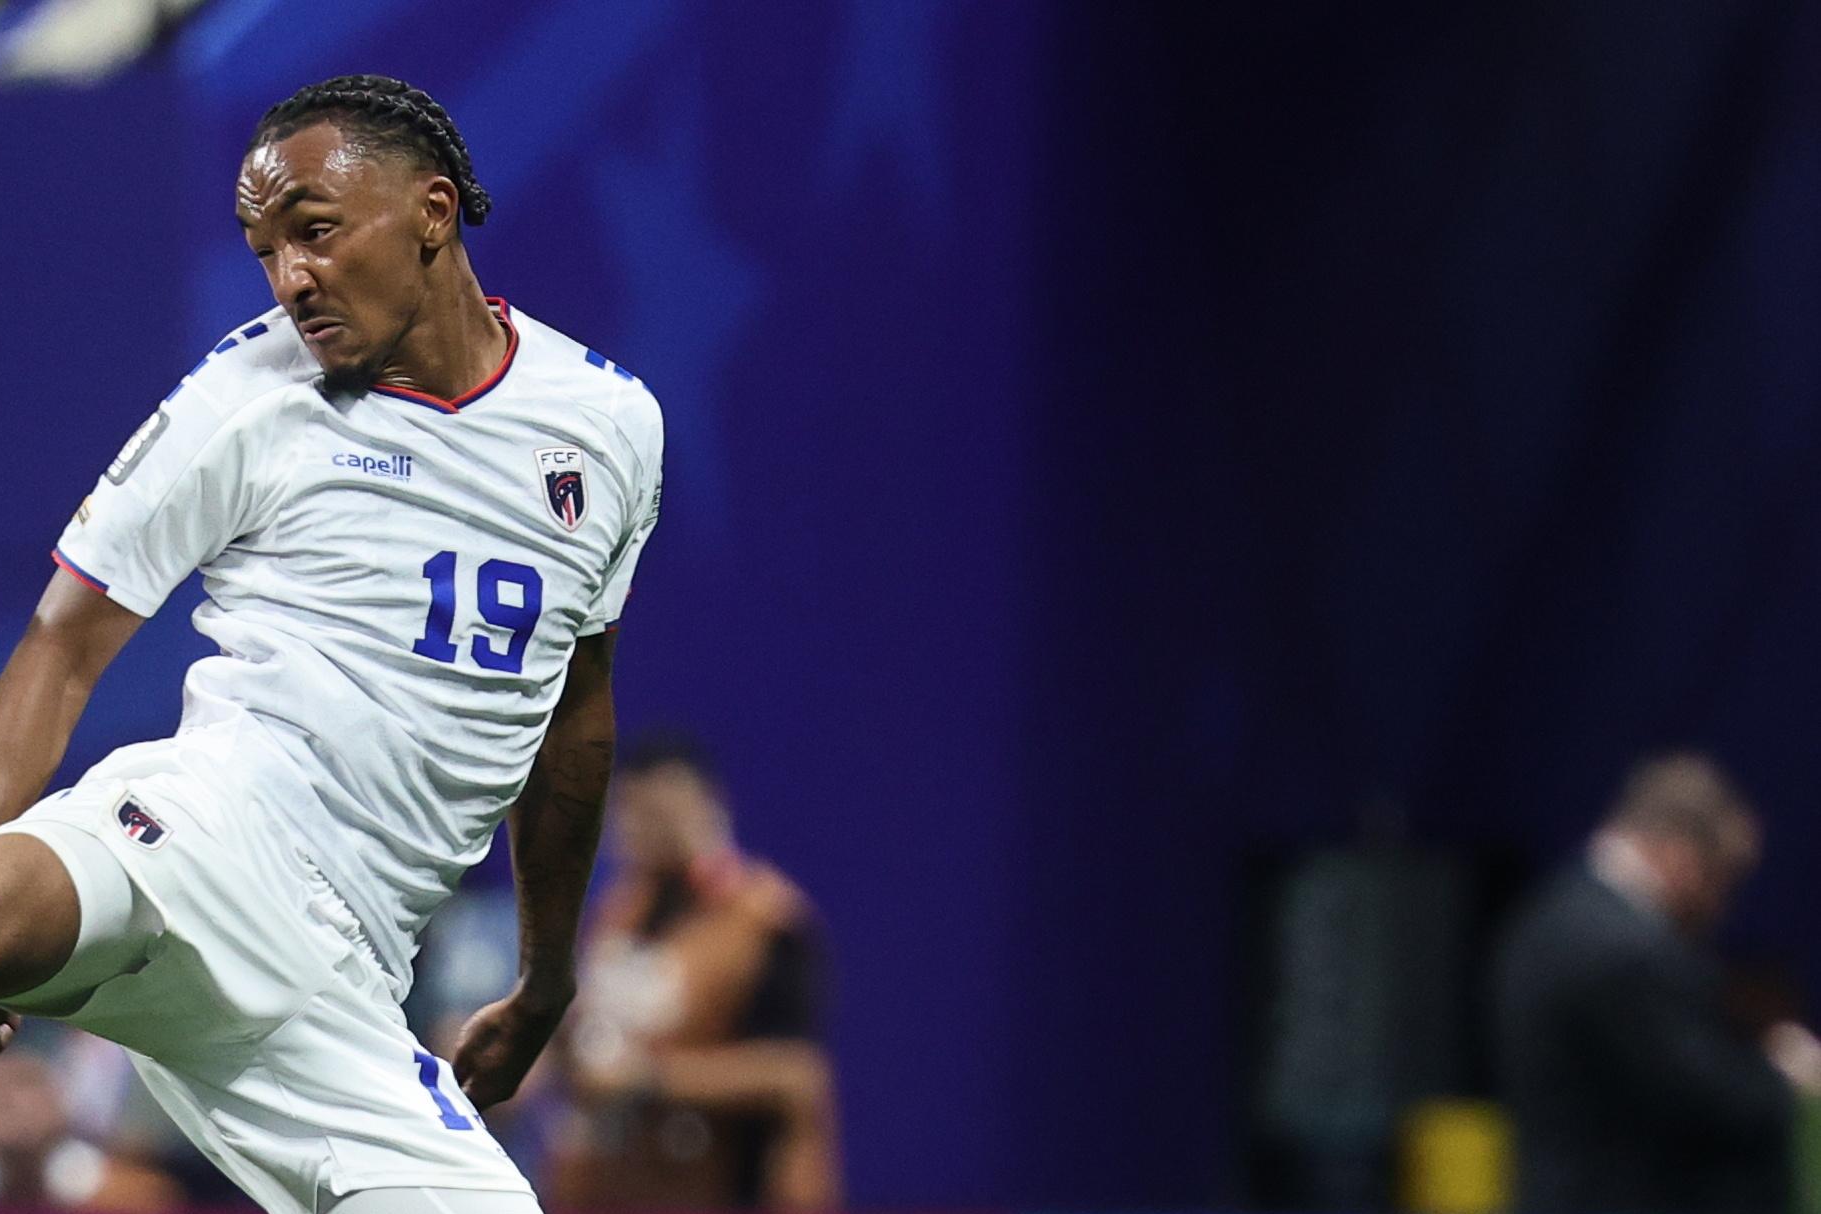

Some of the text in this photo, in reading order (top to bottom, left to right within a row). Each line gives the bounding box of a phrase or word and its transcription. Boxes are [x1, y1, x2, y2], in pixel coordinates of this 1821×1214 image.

[331, 453, 413, 477] capelli
[540, 451, 578, 465] FCF
[412, 550, 543, 674] 19
[413, 1050, 478, 1130] 1
